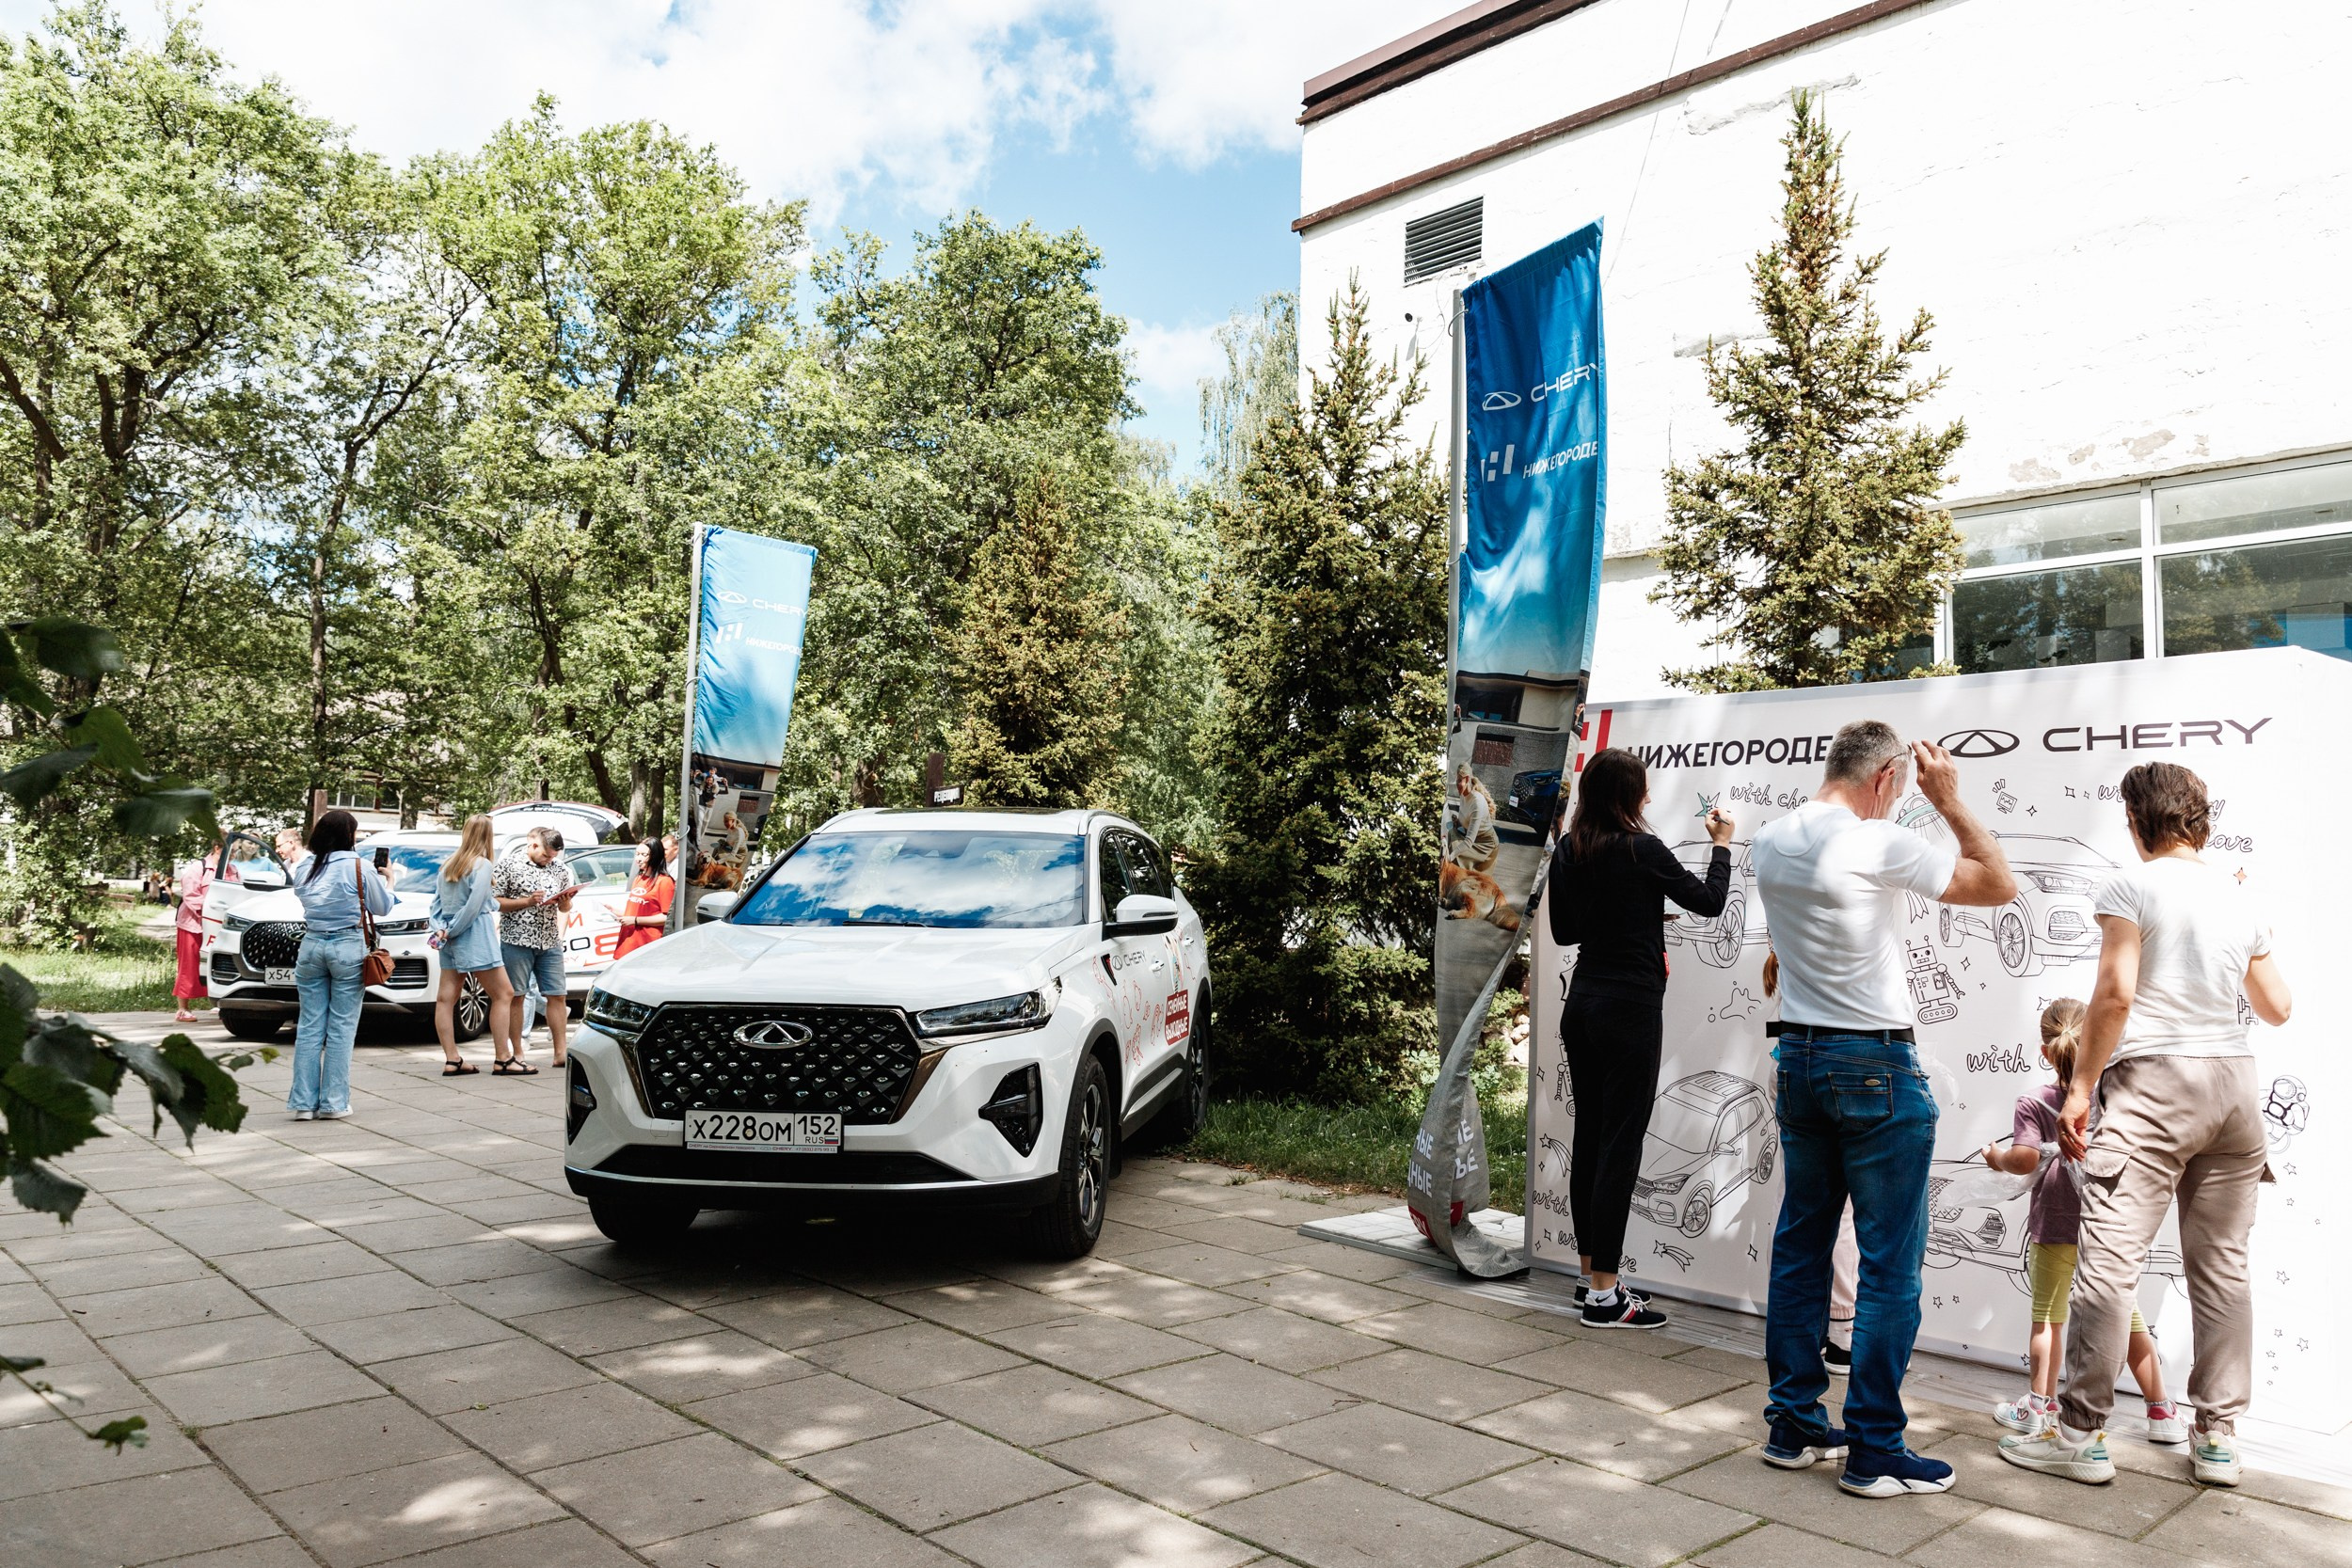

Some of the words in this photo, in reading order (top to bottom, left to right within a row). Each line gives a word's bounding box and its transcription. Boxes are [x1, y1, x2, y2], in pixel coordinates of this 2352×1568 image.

[1523, 441, 1598, 480] НИЖЕГОРОДЕ
[2042, 717, 2273, 752] CHERY
[1627, 736, 1834, 769] ИЖЕГОРОДЕ
[1730, 782, 1772, 806] with
[1123, 950, 1147, 967] CHERY
[1966, 1043, 2031, 1073] with
[797, 1116, 835, 1135] 152
[805, 1136, 824, 1145] RUS
[1532, 1190, 1569, 1217] with
